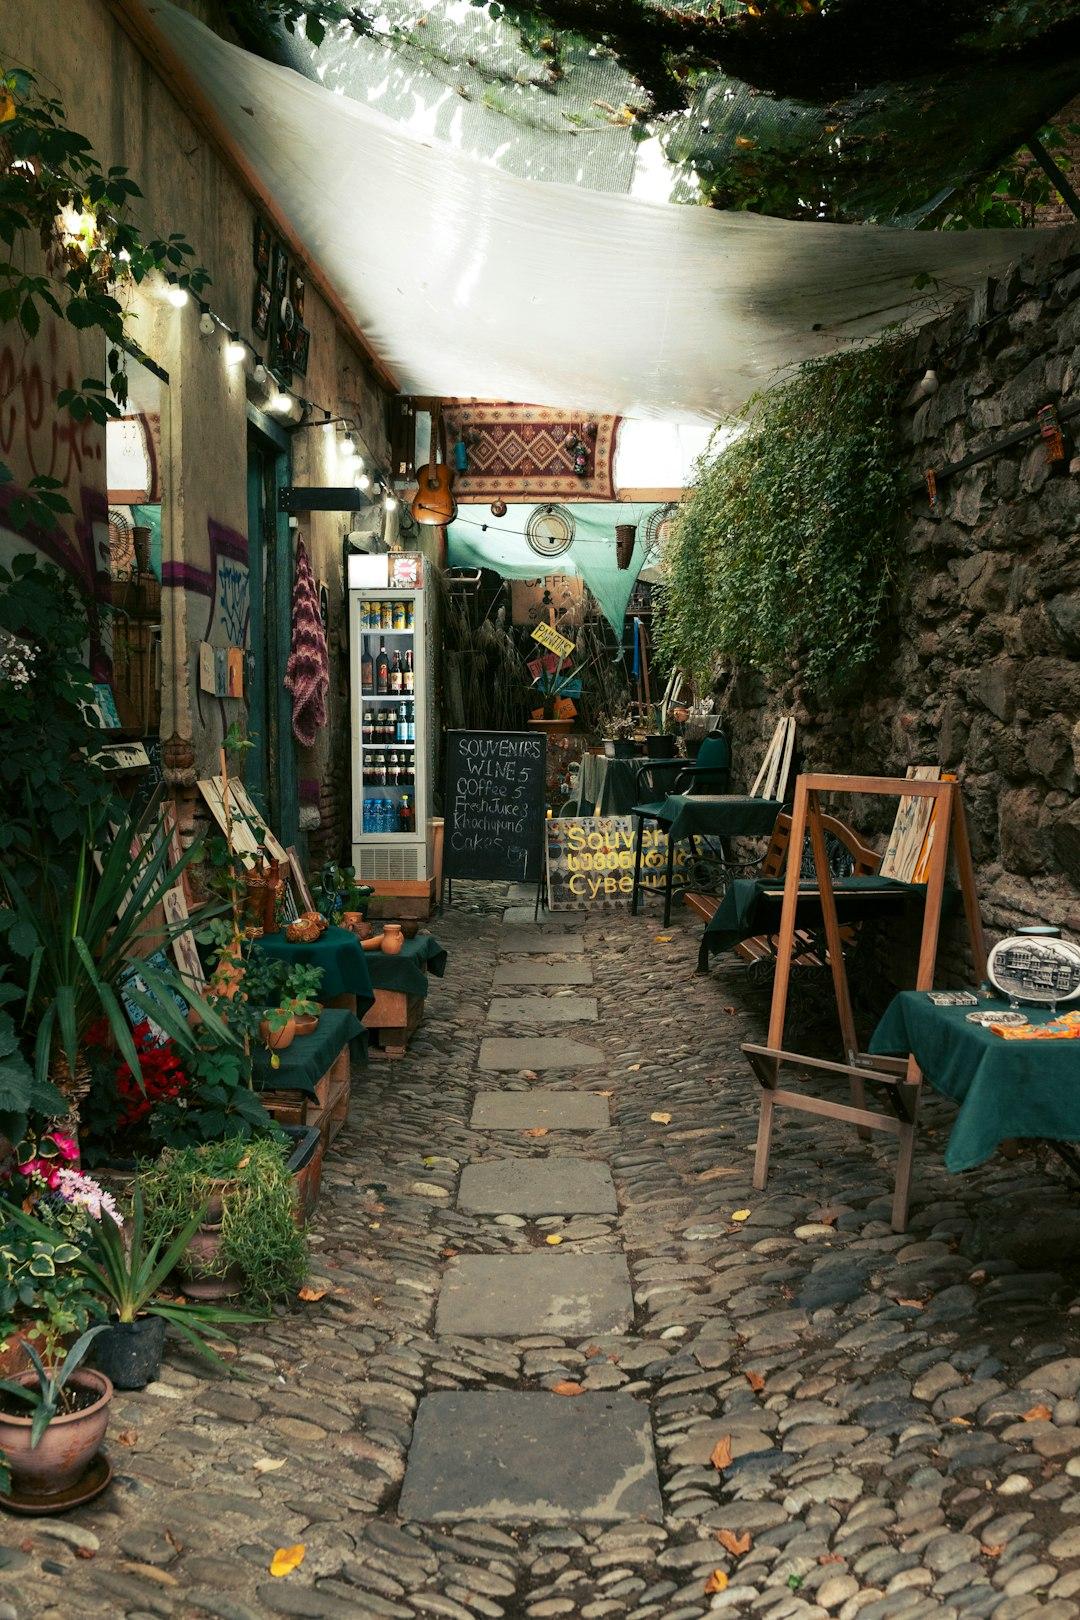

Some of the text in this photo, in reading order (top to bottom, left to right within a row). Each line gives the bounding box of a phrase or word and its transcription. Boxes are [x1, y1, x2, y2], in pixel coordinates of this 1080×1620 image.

[543, 590, 553, 605] &
[458, 738, 541, 759] SOUVENIRS
[466, 757, 516, 781] WINE
